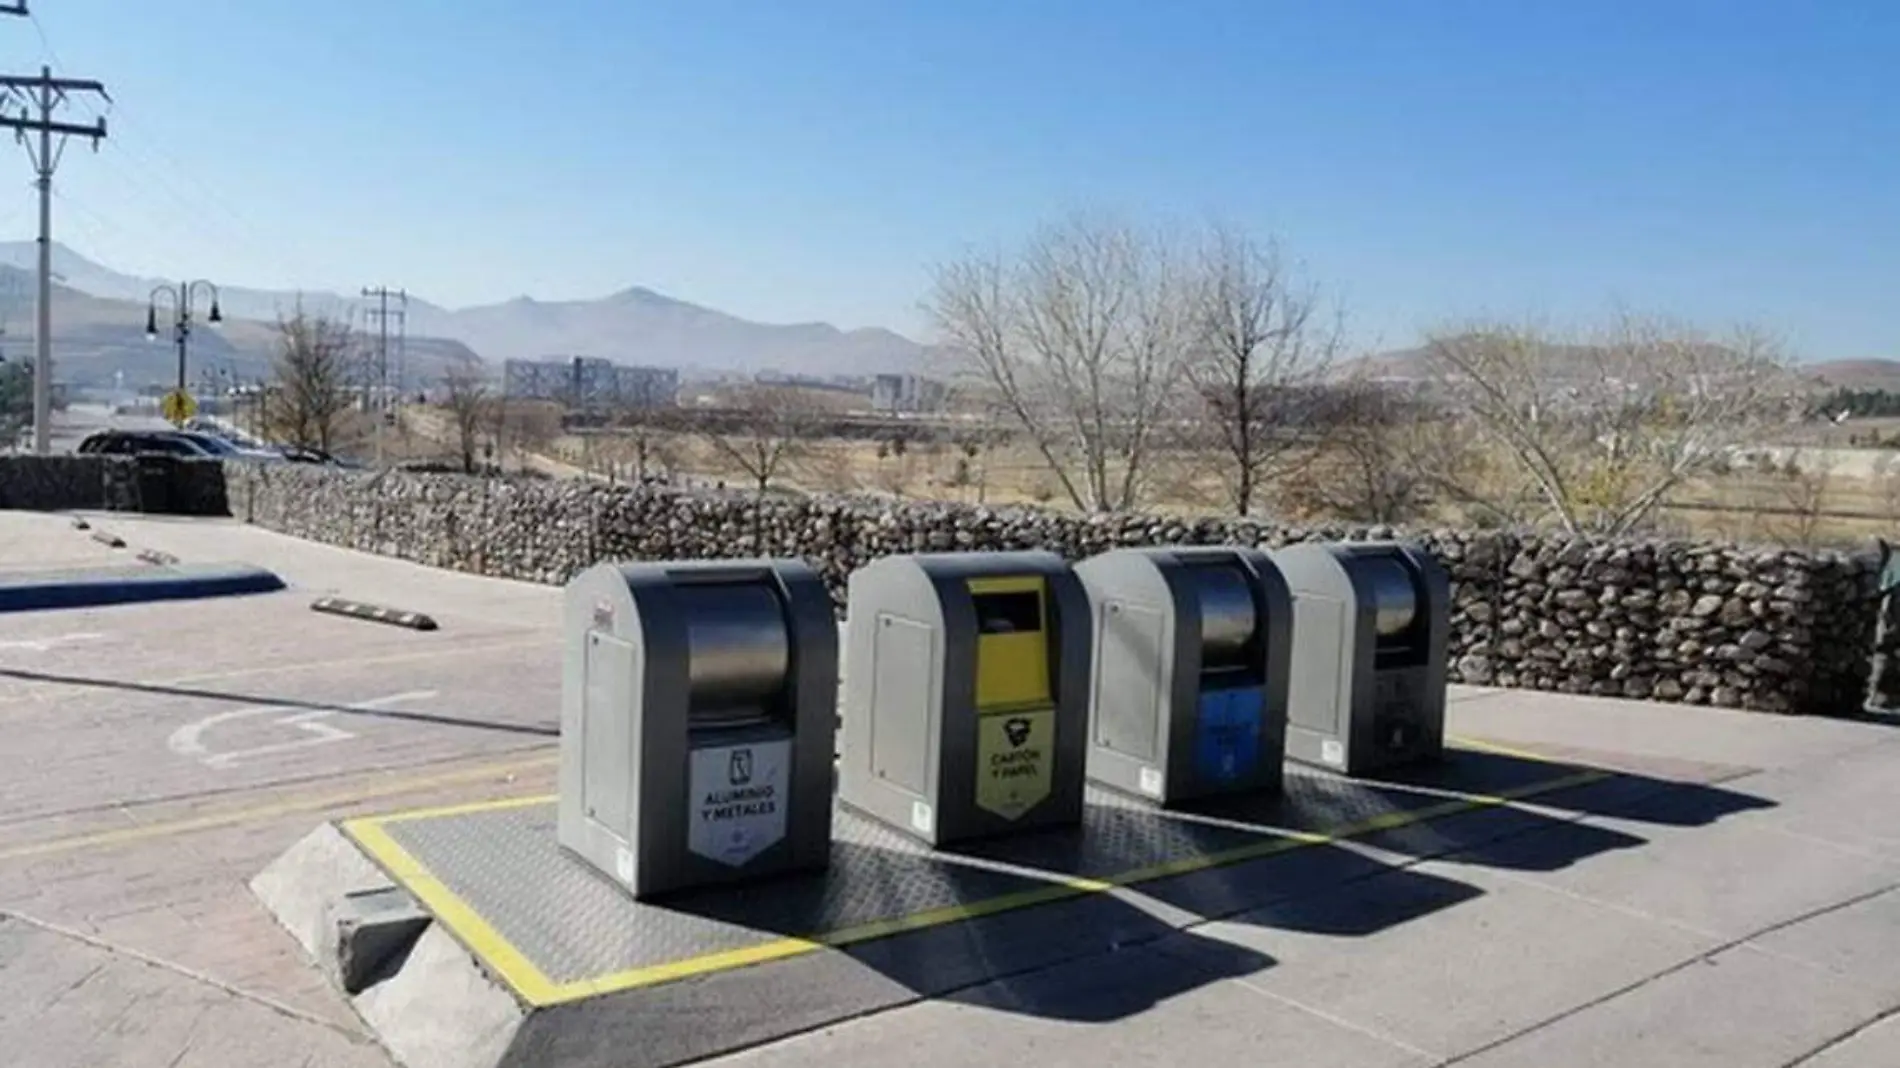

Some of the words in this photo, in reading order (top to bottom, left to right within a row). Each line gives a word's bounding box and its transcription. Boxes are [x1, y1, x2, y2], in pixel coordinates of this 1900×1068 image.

[704, 785, 775, 805] ALUMINIO
[702, 808, 713, 821] Y
[714, 801, 775, 821] METALES
